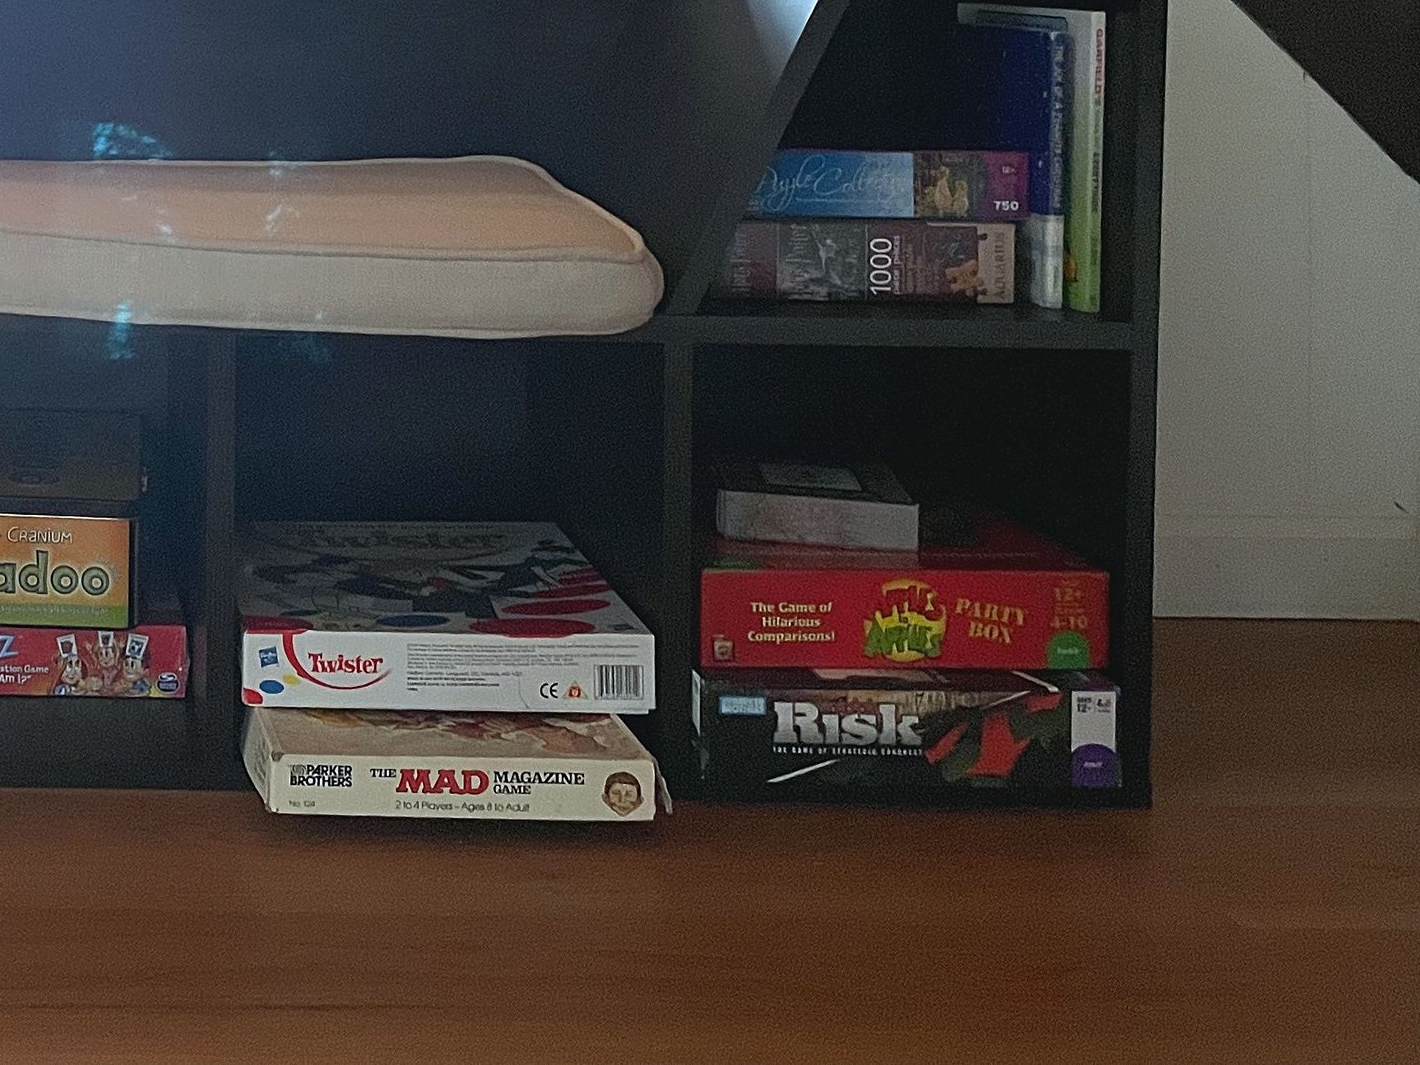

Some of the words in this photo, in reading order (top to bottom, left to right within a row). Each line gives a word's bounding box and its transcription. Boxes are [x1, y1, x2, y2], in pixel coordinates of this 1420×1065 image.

[993, 200, 1020, 212] 750
[869, 238, 893, 295] 1000
[1052, 587, 1084, 602] 12+
[750, 602, 776, 613] The
[779, 602, 816, 613] Game
[820, 601, 833, 613] of
[954, 597, 1028, 627] PARTY
[762, 615, 821, 627] Hilarious
[747, 630, 836, 644] Comparisons!
[968, 619, 1014, 644] BOX
[23, 665, 49, 674] Game
[308, 652, 384, 674] Twister
[306, 764, 353, 777] PARKER
[290, 775, 353, 788] BROTHERS
[370, 768, 397, 779] THE
[396, 768, 490, 795] MAD
[493, 771, 585, 785] MAGAZINE
[493, 784, 532, 795] GAME
[395, 801, 403, 810] 2
[403, 801, 412, 810] to
[413, 801, 420, 810] 4
[421, 801, 454, 813] Players
[461, 802, 484, 814] Ages
[494, 802, 504, 811] to
[505, 802, 530, 812] Adult
